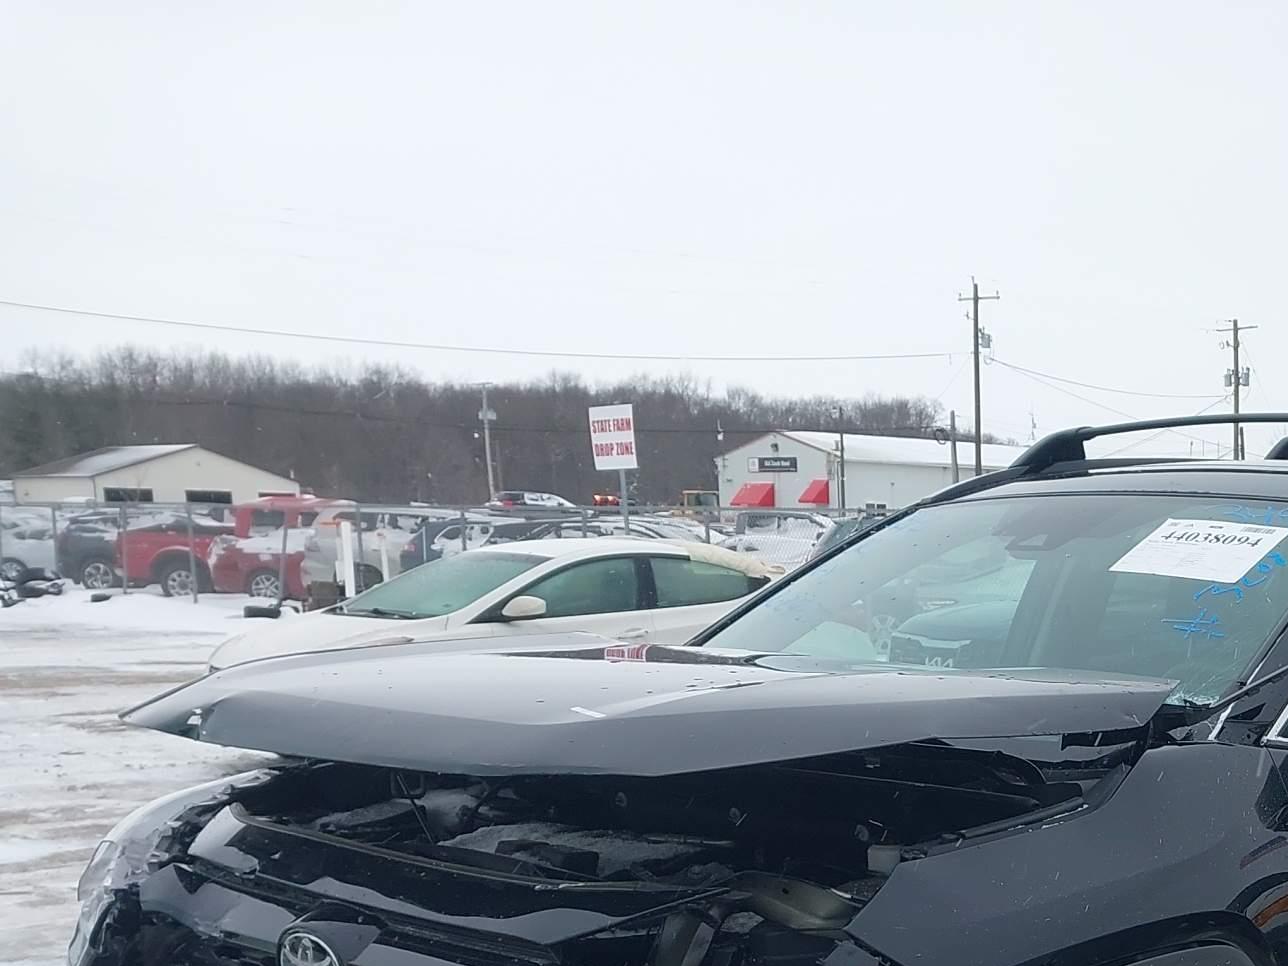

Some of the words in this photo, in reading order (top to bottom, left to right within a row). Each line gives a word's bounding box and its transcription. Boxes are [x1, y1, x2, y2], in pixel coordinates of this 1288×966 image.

[592, 419, 612, 434] STATE
[613, 417, 632, 432] FARM
[594, 443, 614, 457] DROP
[616, 442, 634, 456] ZONE
[1161, 531, 1263, 547] 44038094
